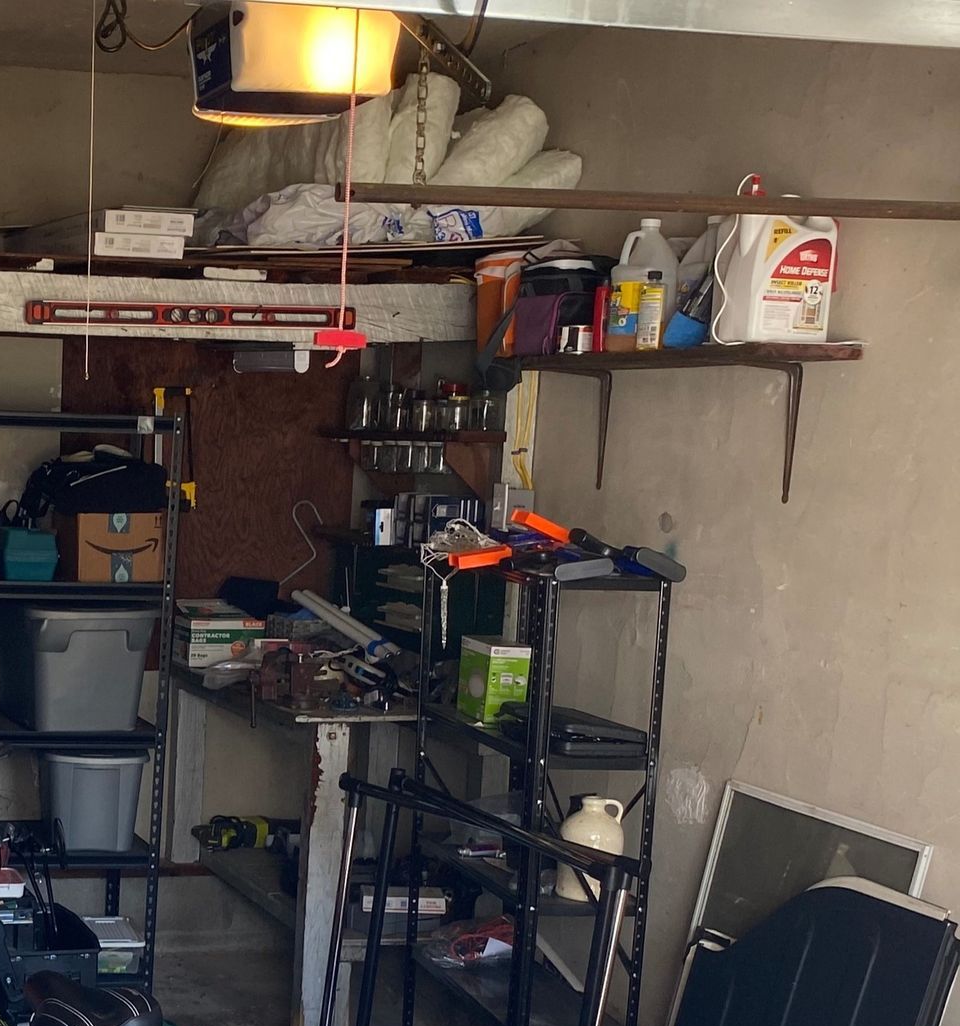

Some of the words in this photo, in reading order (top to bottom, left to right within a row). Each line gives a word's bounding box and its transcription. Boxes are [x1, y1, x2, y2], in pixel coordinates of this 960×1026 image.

[780, 265, 802, 275] HOME
[801, 266, 829, 277] DEFENSE
[810, 285, 819, 294] 12
